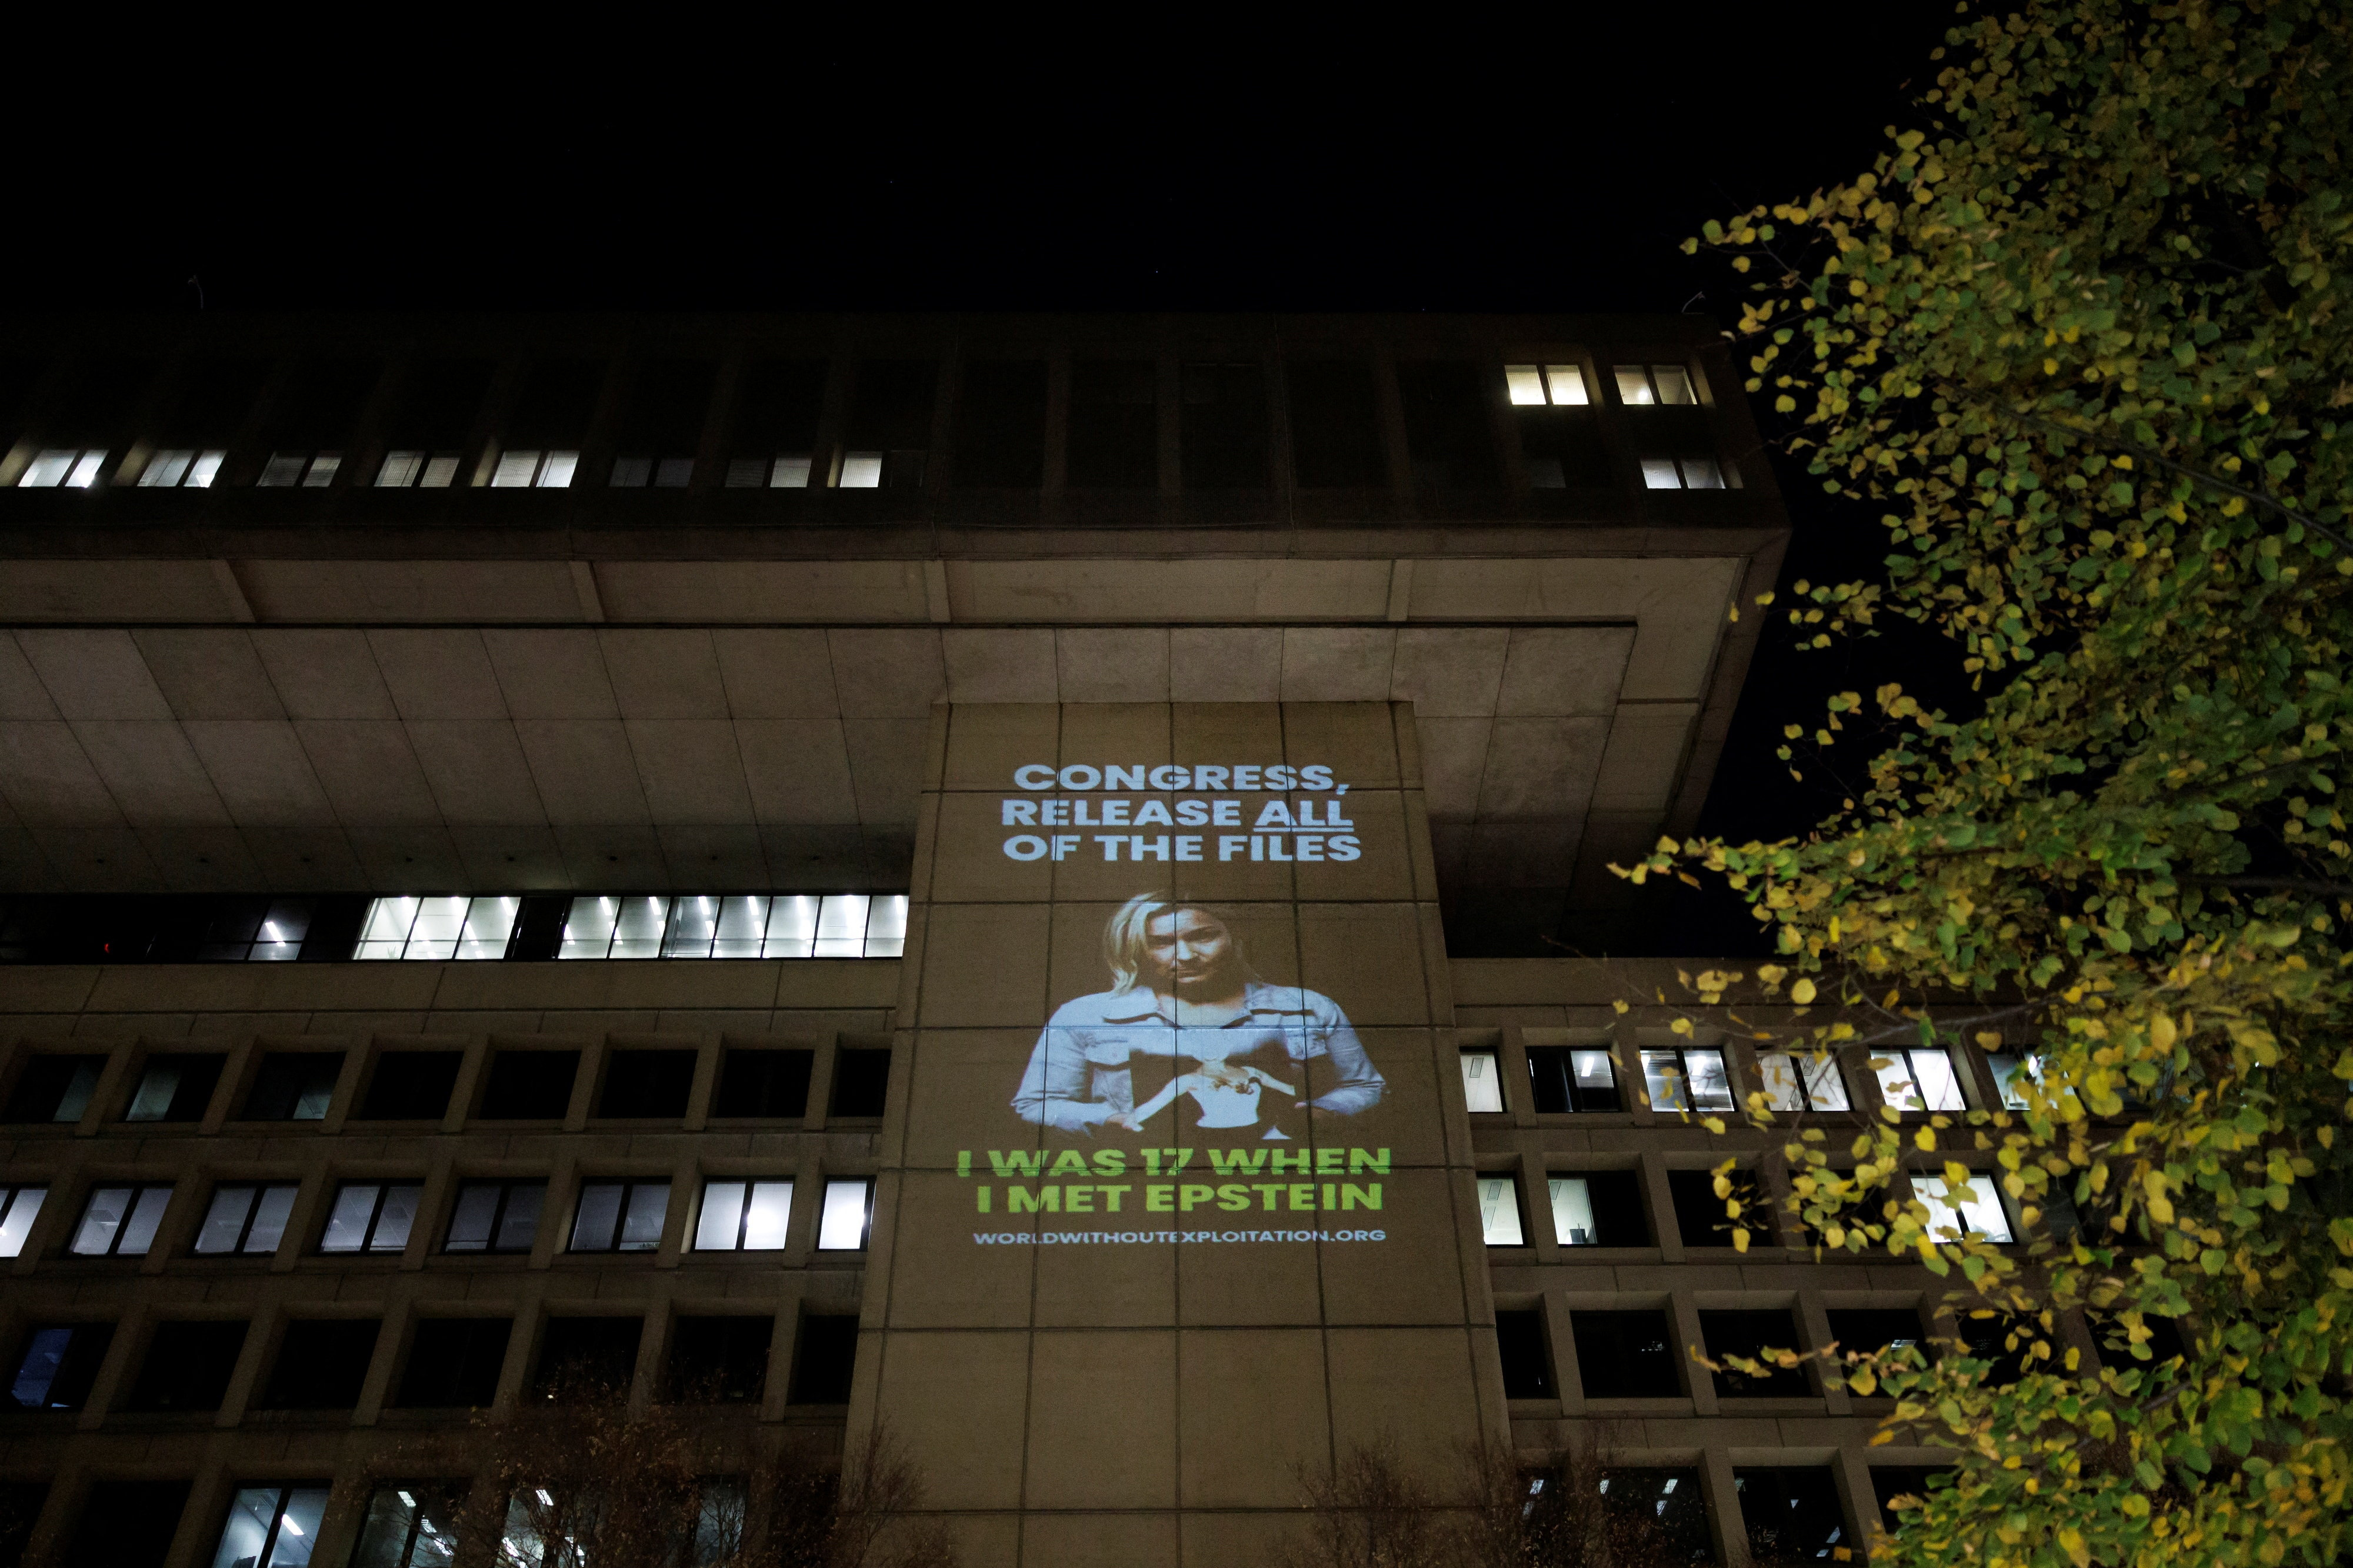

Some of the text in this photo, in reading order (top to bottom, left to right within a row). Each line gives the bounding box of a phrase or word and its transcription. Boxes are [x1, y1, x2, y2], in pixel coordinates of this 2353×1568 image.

[1014, 764, 1349, 795] CONGRESS,
[1002, 800, 1354, 826] RELEASE ALL
[1003, 835, 1361, 862] OF THE FILES
[957, 1147, 1391, 1177] I WAS 17 WHEN
[977, 1183, 1382, 1213] I MET EPSTEIN
[973, 1230, 1386, 1245] WORLDWITHOUTEXPLOITATION.ORG
